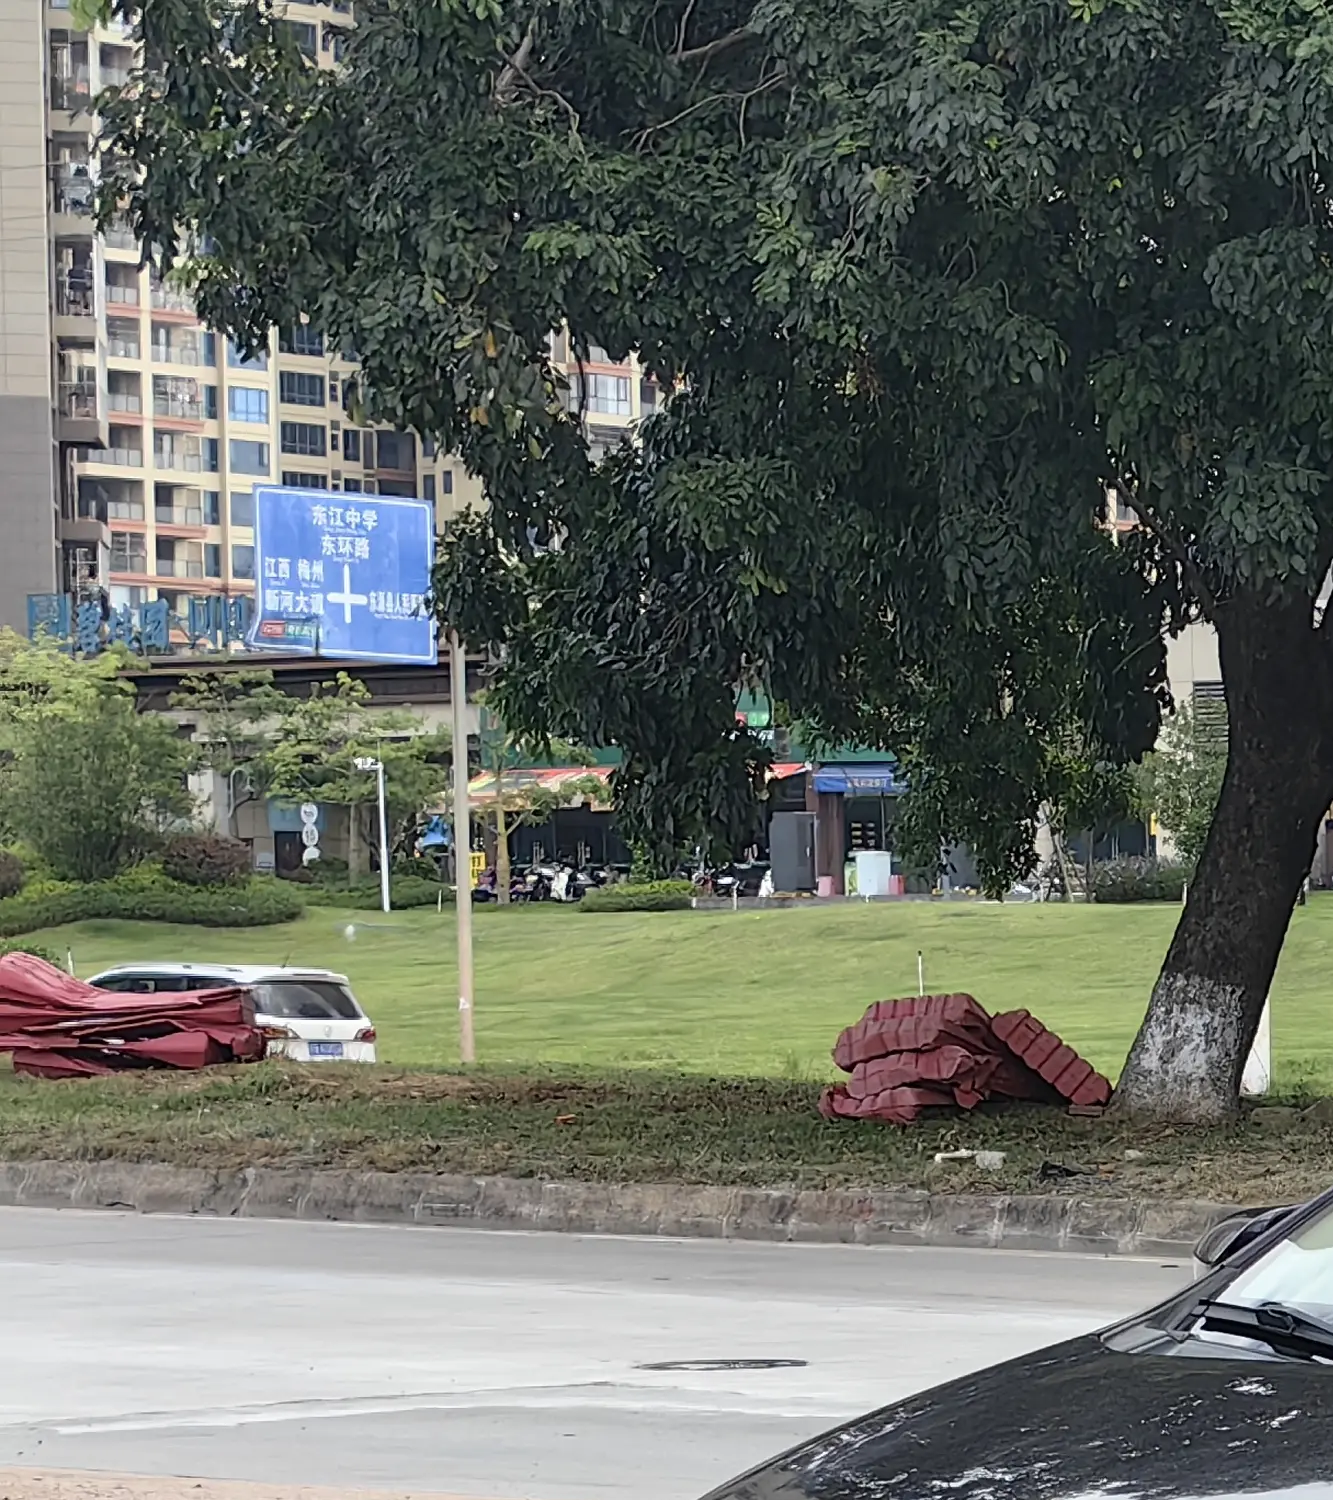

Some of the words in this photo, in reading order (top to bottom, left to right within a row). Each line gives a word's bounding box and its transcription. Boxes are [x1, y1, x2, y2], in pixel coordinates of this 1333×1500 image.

[312, 504, 378, 531] 东江中学
[321, 534, 369, 559] 东环路
[264, 556, 291, 579] 江西
